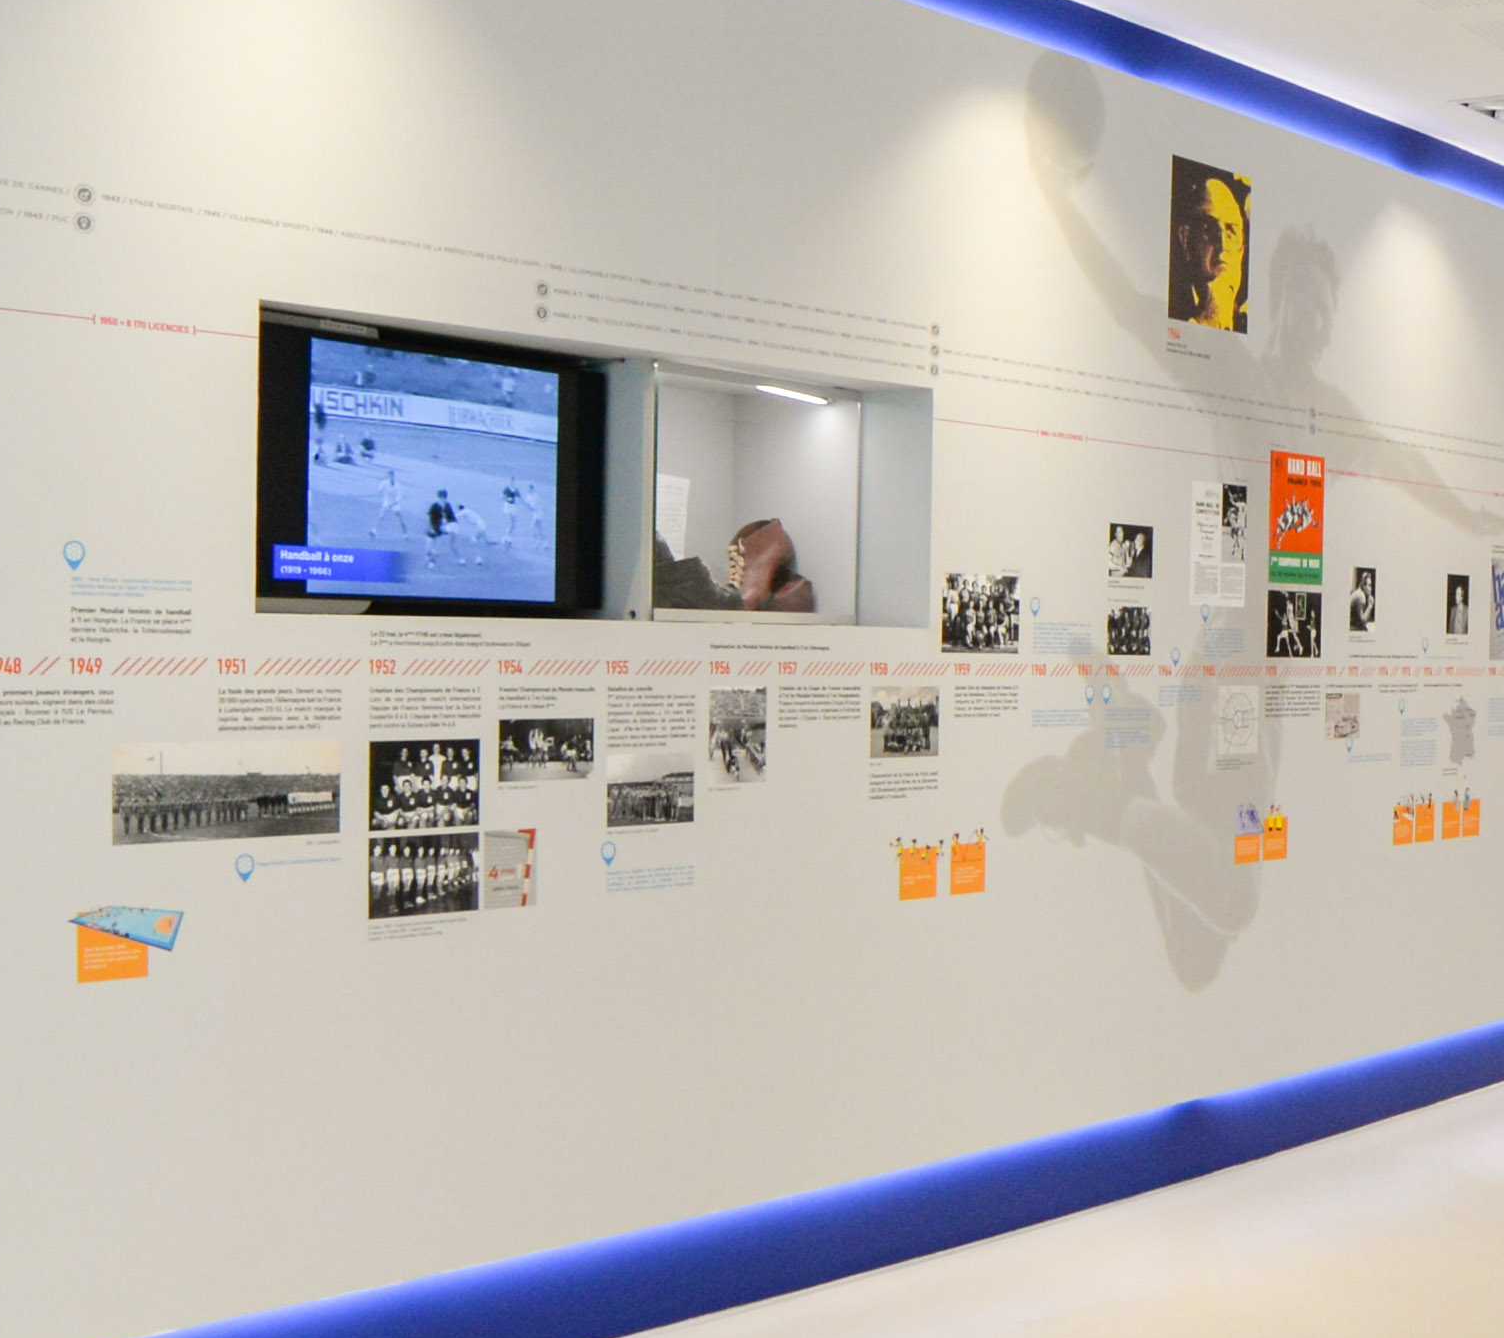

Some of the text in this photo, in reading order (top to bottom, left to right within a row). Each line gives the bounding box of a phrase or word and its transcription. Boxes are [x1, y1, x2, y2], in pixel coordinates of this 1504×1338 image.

[280, 549, 322, 563] Handball
[332, 552, 354, 563] onze
[70, 606, 96, 614] Premier
[69, 657, 103, 673] 1949
[217, 657, 247, 675] 1951
[369, 658, 396, 675] 1952
[497, 659, 524, 674] 1954
[605, 660, 630, 675] 1955
[708, 660, 731, 675] 1956
[778, 660, 798, 675] 1957
[869, 661, 889, 675] 1958
